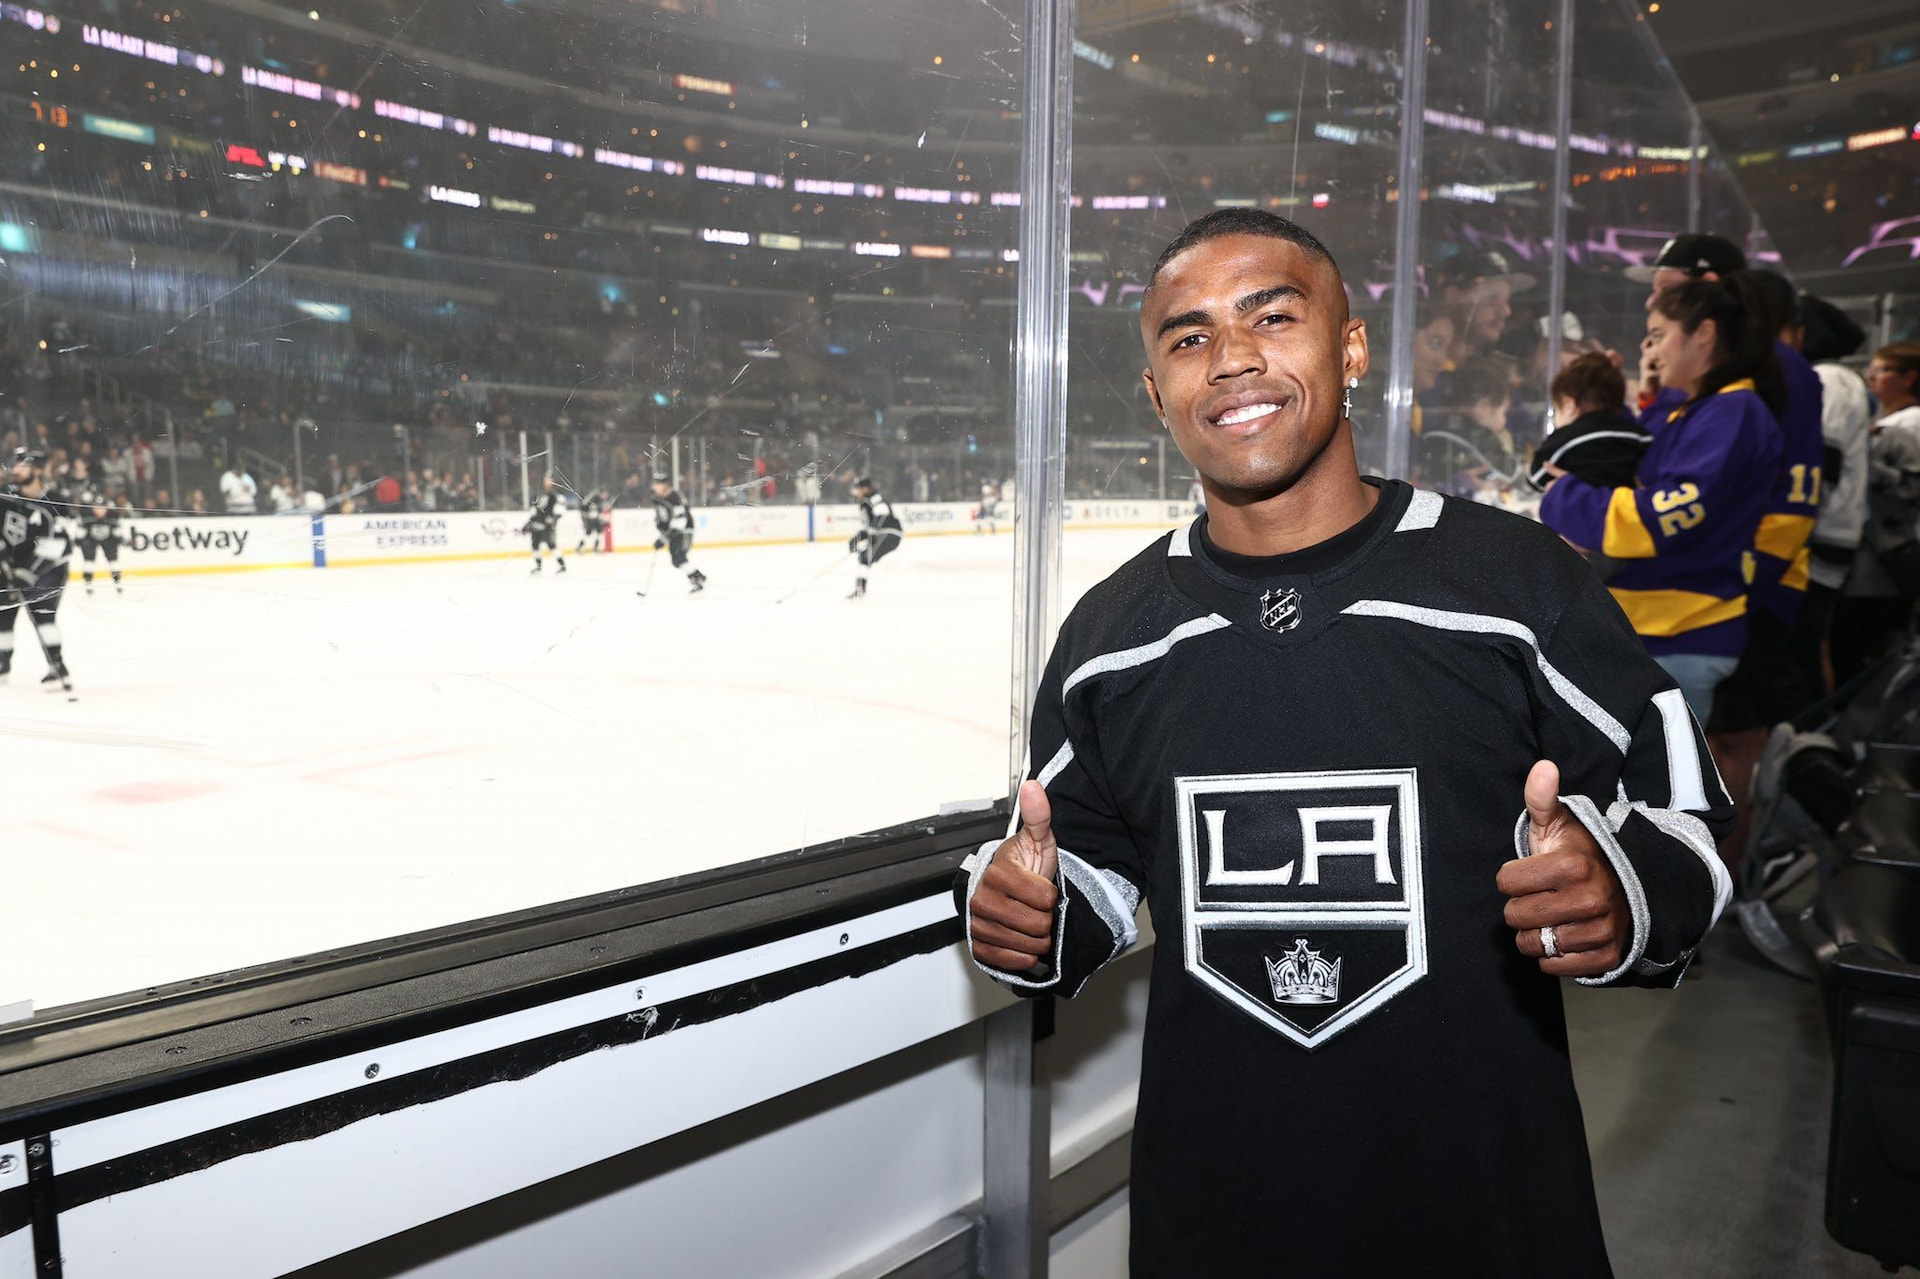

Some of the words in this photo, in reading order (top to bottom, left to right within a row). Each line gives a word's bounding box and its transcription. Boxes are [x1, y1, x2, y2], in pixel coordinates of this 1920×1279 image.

[1787, 464, 1821, 506] 11
[1652, 483, 1705, 537] 32
[130, 525, 248, 556] betway
[1203, 804, 1397, 886] LA
